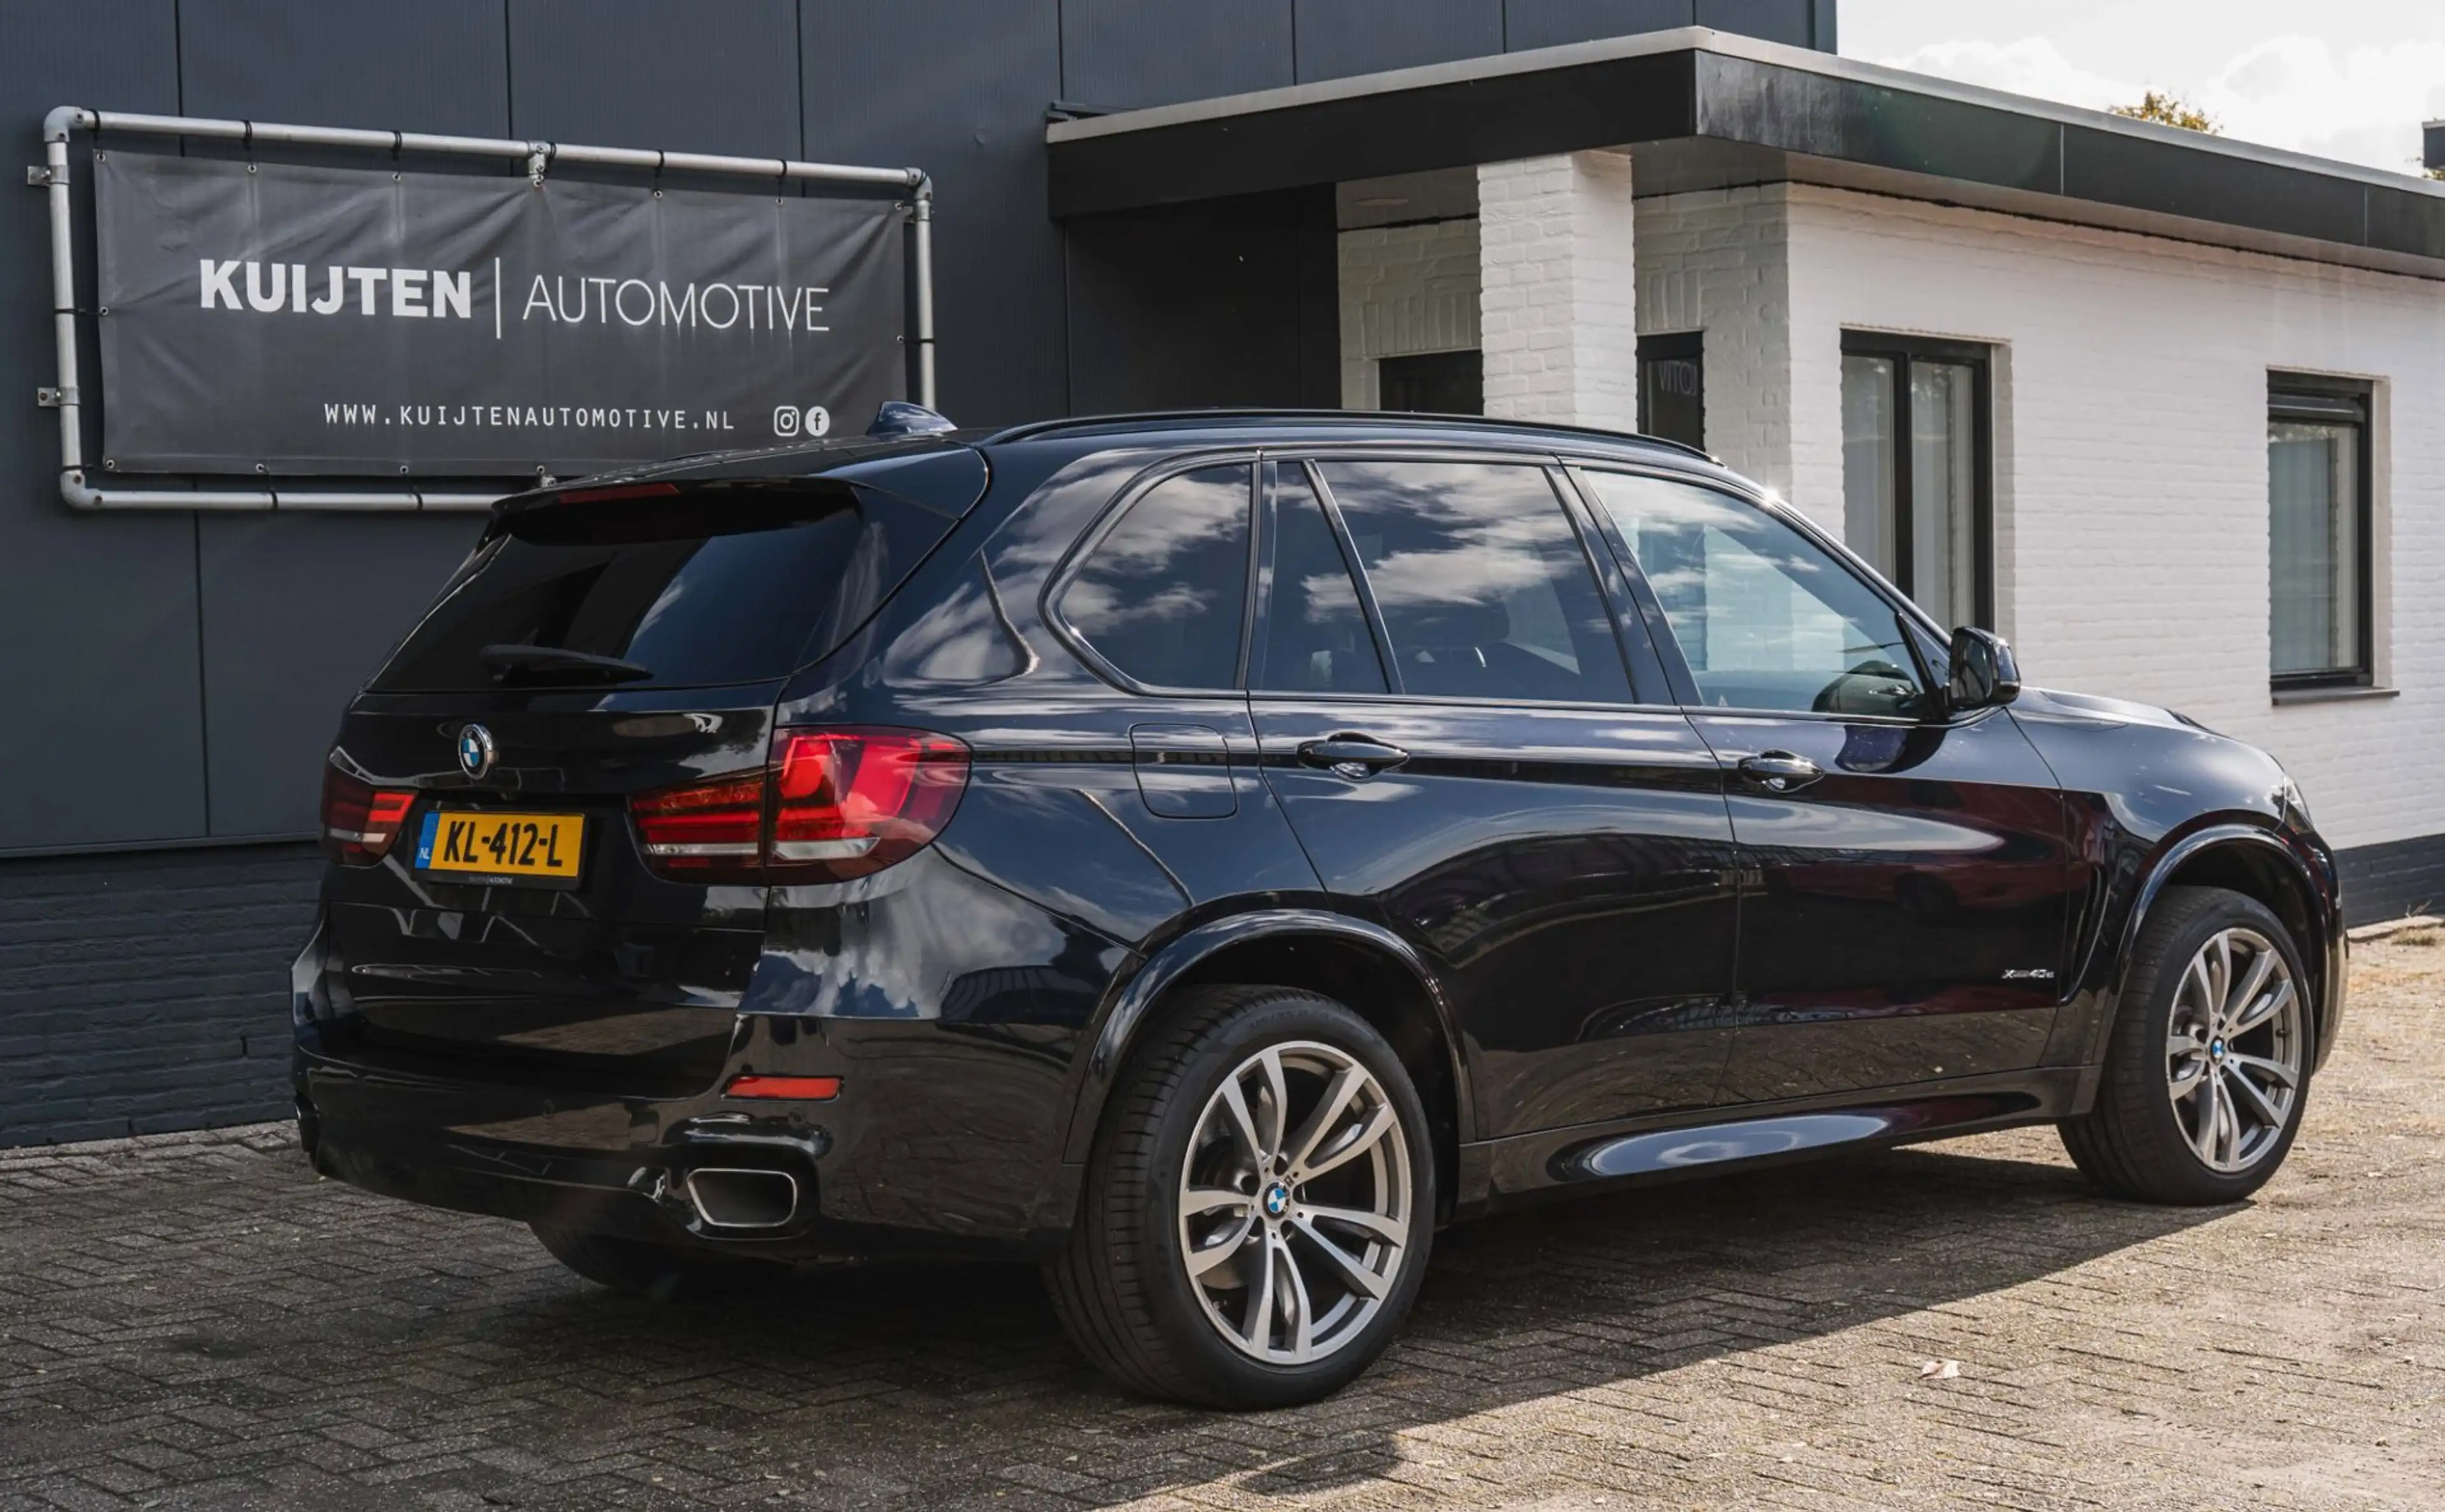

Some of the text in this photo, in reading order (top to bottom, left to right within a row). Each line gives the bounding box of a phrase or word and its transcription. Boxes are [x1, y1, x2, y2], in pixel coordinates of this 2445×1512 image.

[199, 258, 830, 332] KUIJTEN AUTOMOTIVE
[324, 403, 734, 430] WWW.KUIJTENAUTOMOTIVE.NL
[418, 847, 430, 860] NL
[443, 821, 562, 867] KL-412-L
